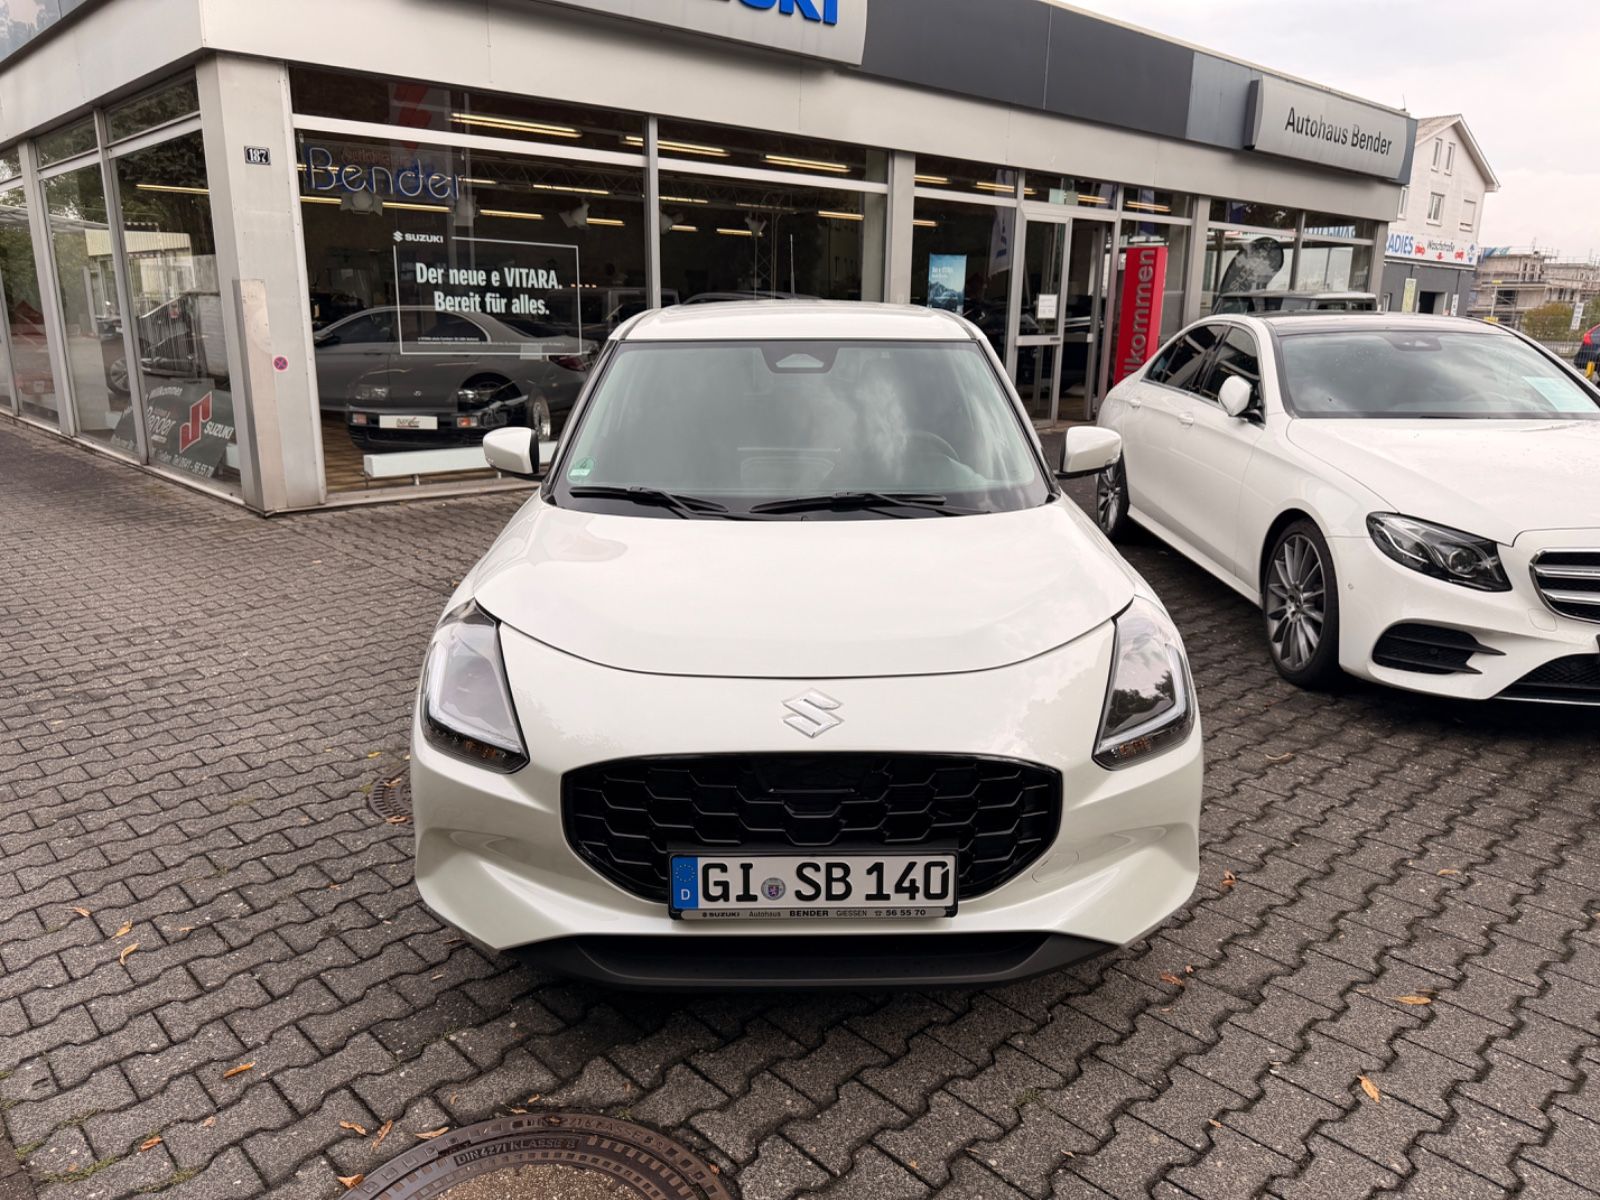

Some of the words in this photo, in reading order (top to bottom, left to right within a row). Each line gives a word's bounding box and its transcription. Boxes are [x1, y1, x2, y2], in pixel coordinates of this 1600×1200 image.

[1284, 106, 1349, 146] Autohaus
[1350, 123, 1393, 156] Bender
[249, 148, 267, 162] 187
[309, 147, 463, 200] Bender
[404, 233, 444, 243] SUZUKI
[1387, 233, 1414, 255] ADIES
[415, 262, 444, 284] Der
[449, 268, 487, 287] neue
[491, 270, 500, 287] e
[504, 267, 563, 290] VITARA.
[434, 291, 482, 314] Bereit
[485, 292, 508, 314] für
[511, 294, 550, 316] alles.
[203, 421, 235, 440] SUZUKI
[702, 862, 758, 902] GI
[795, 862, 852, 902] SB
[865, 861, 950, 901] 140
[681, 888, 691, 901] D
[749, 910, 782, 918] Autohaus
[789, 910, 829, 918] BENDER
[836, 909, 868, 917] GIESSEN
[886, 909, 898, 917] 56
[900, 909, 912, 917] 55
[455, 1150, 480, 1165] DIN
